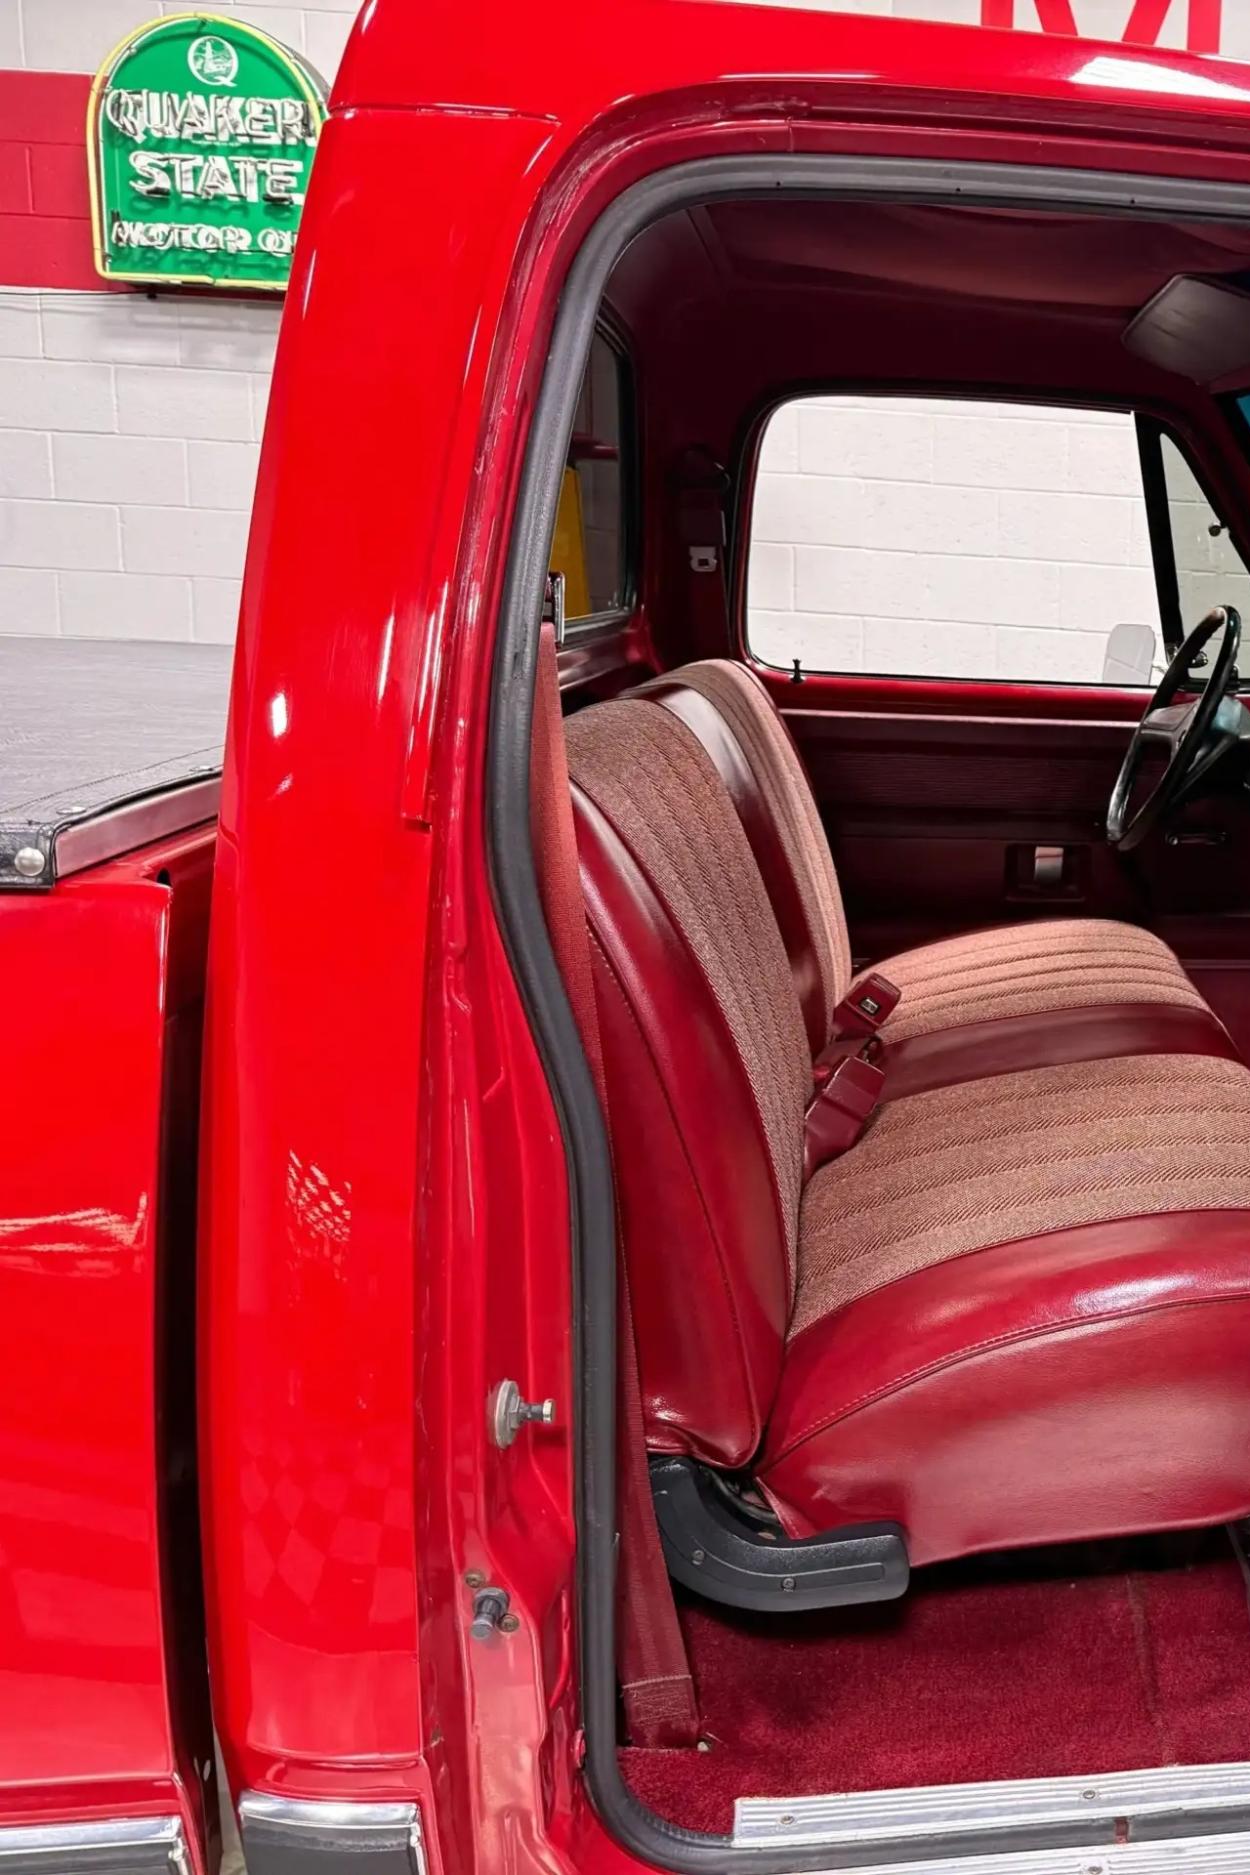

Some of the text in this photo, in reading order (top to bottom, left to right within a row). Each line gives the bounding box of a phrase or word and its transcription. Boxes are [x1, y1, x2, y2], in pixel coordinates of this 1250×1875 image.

[105, 89, 316, 147] QUAKER
[128, 151, 304, 205] STATE
[111, 221, 252, 254] MOTOR
